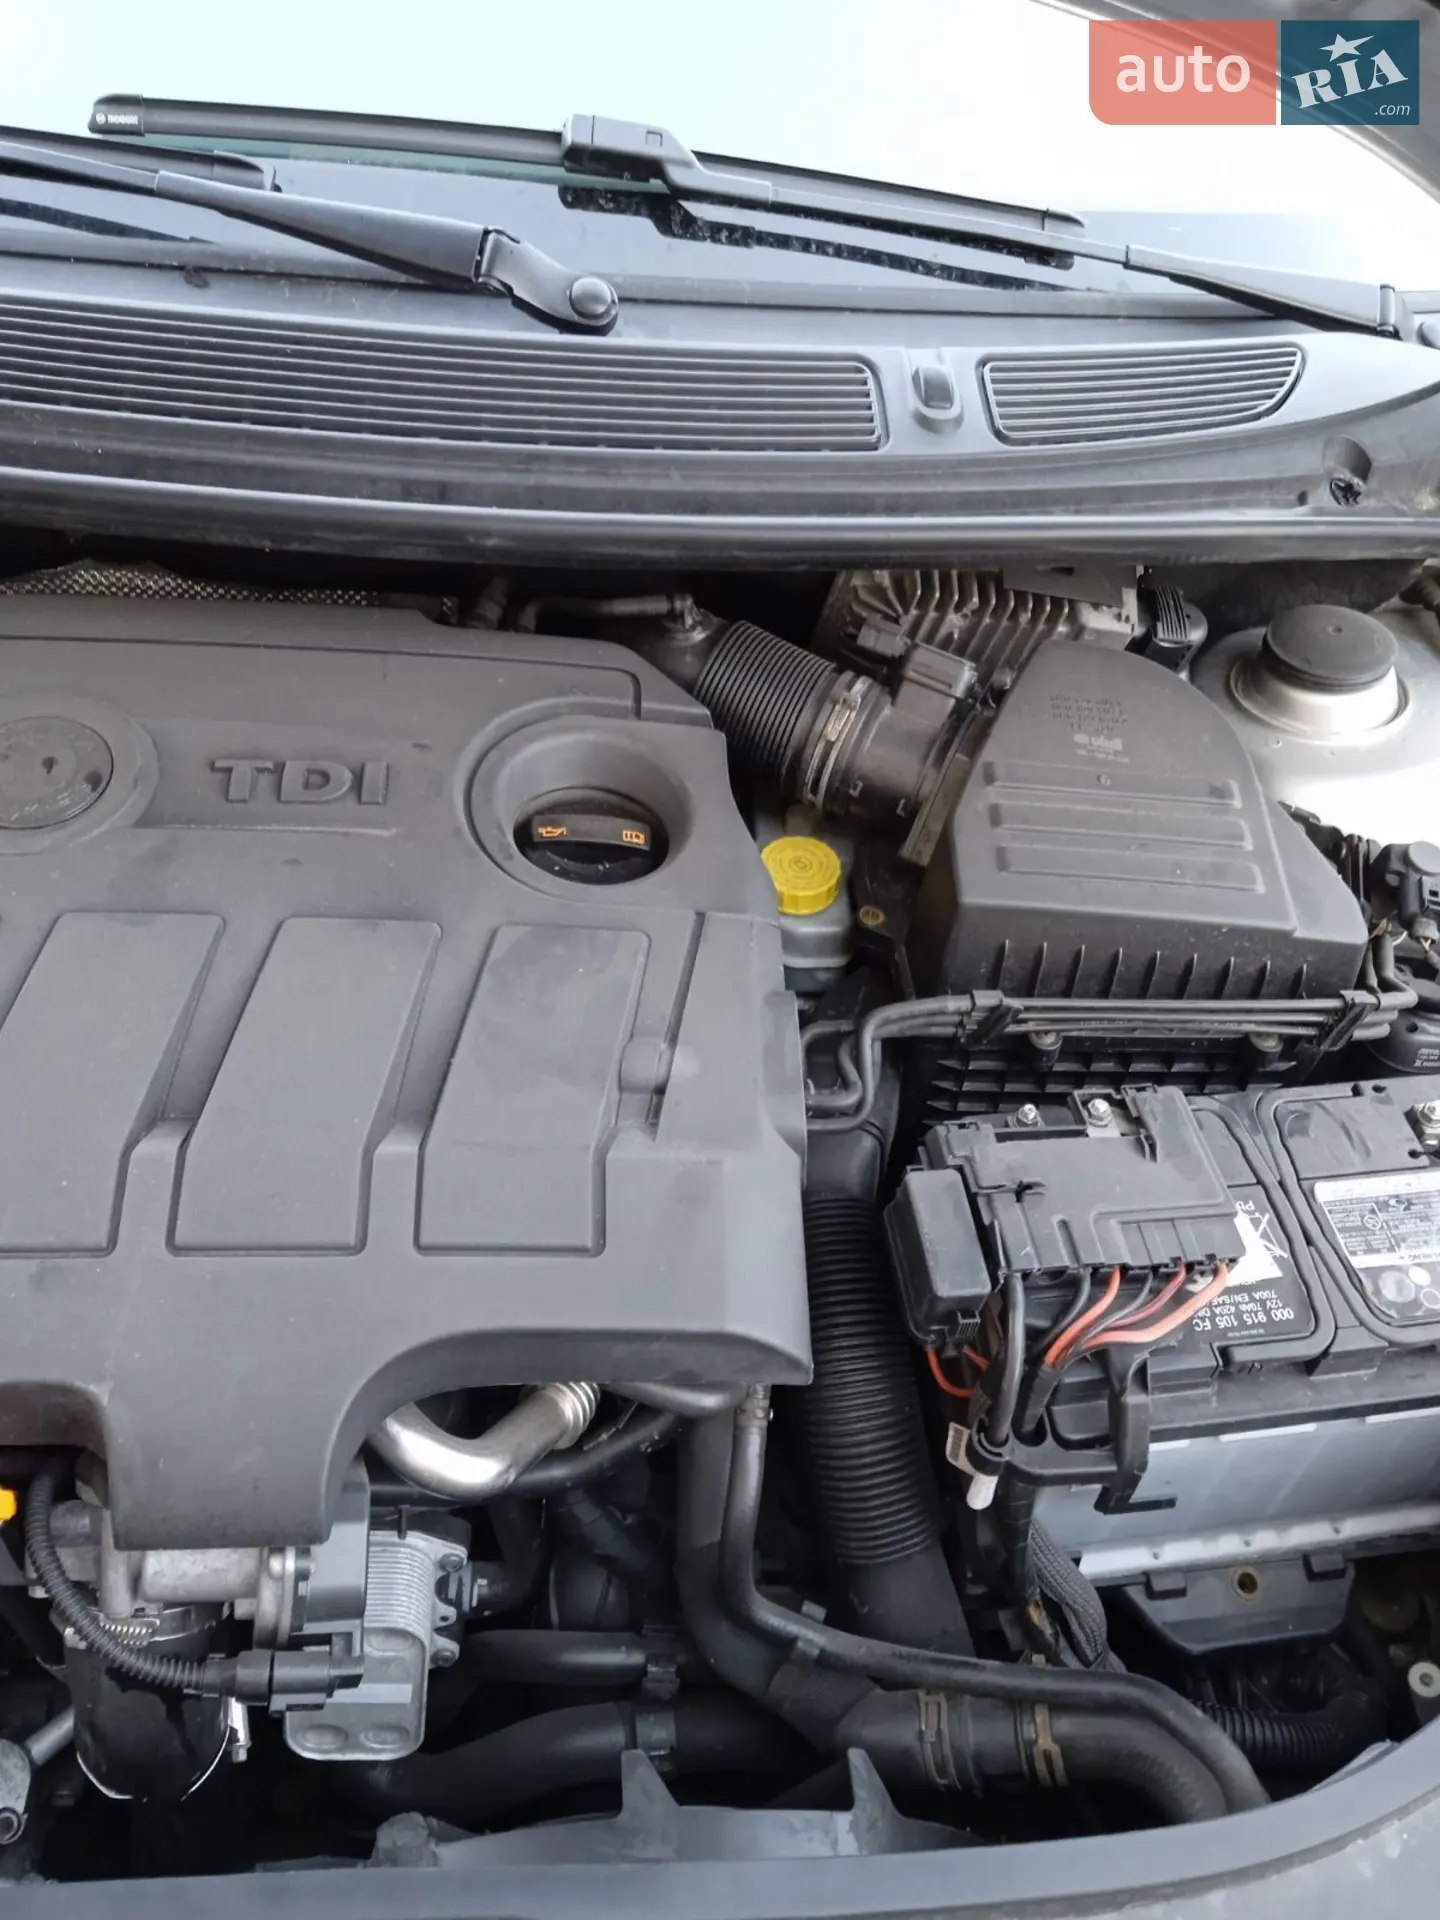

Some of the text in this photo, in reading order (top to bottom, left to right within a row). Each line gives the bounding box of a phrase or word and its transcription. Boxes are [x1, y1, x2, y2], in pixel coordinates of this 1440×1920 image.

[210, 759, 390, 806] TDI
[1252, 1289, 1278, 1300] 700A
[1213, 1305, 1236, 1315] 420A
[1266, 1299, 1282, 1310] 12V
[1192, 1307, 1294, 1331] 000 915 105 FC
